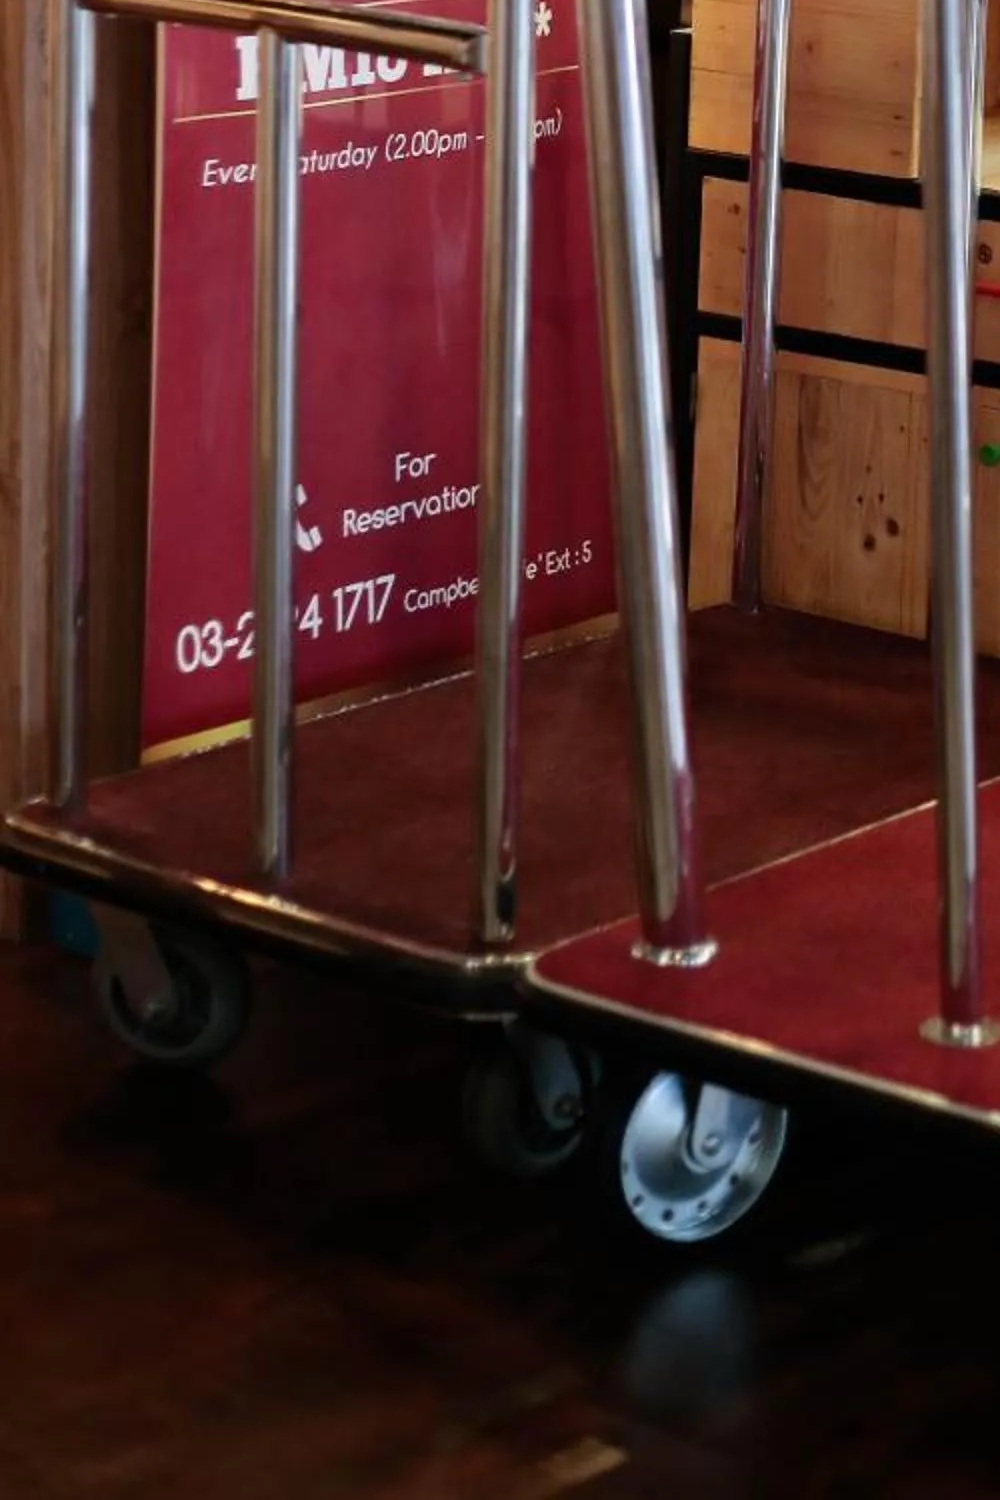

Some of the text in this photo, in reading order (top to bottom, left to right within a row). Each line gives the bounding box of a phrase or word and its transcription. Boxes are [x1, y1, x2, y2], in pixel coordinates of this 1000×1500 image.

[202, 158, 257, 188] Ever
[299, 143, 377, 177] aturday
[384, 129, 468, 163] (2.00pm
[395, 452, 436, 482] For
[176, 593, 323, 674] 03-24
[332, 574, 396, 633] 1717
[545, 547, 571, 575] Ext
